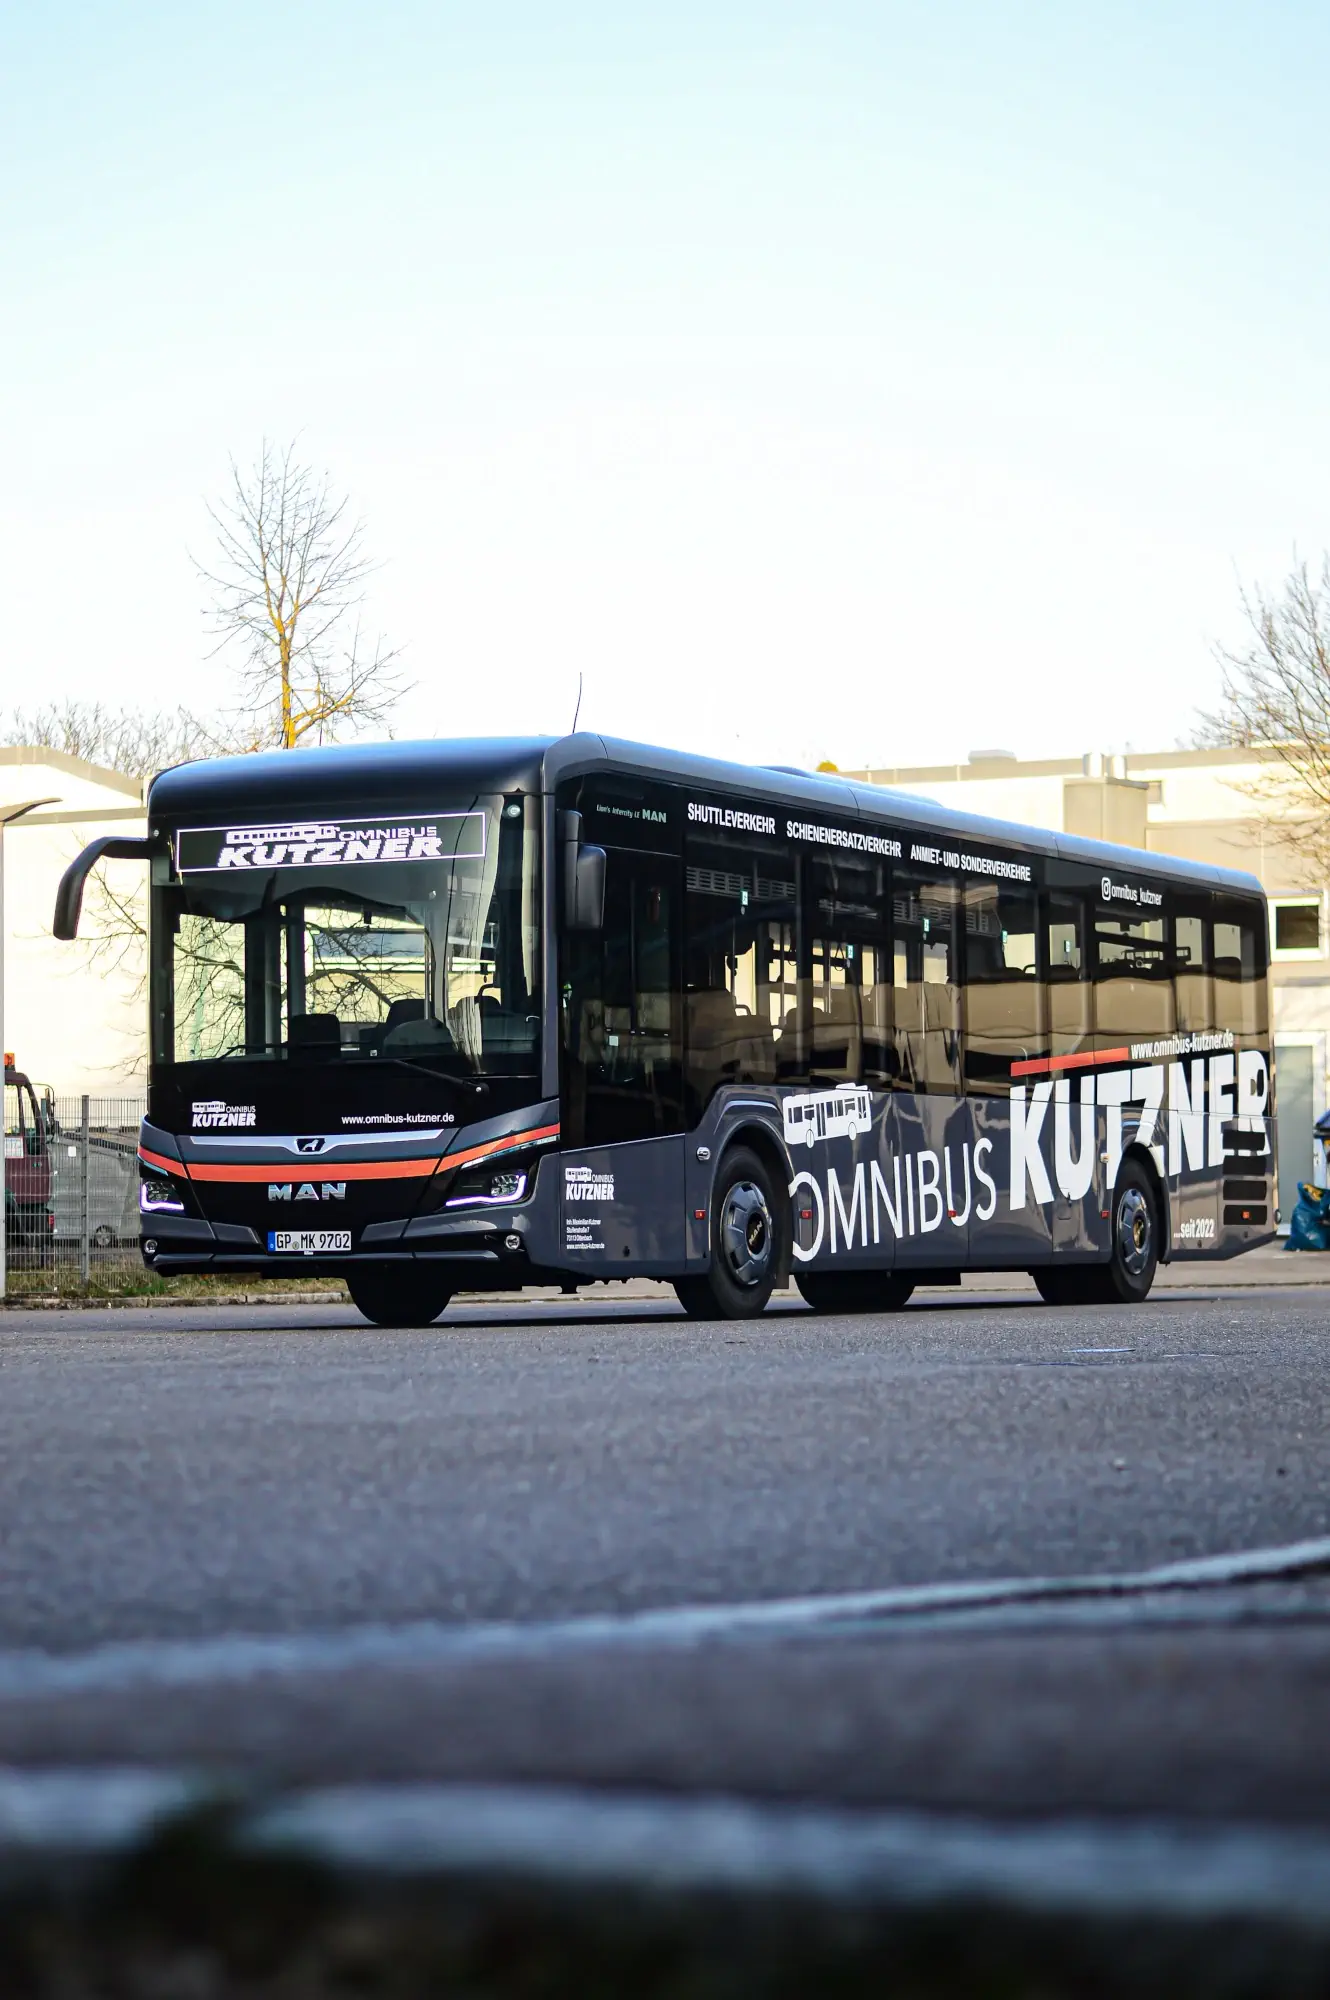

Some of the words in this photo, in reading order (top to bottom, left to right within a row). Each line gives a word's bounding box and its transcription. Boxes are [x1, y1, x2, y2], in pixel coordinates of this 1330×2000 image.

[642, 808, 667, 823] MAN
[338, 826, 437, 842] OMNIBUS
[687, 802, 776, 834] SHUTTLEVERKEHR
[786, 820, 901, 858] SCHIENENERSATZVERKEHR
[943, 852, 960, 869] UND
[960, 854, 1031, 882] SONDERVERKEHRE
[217, 836, 442, 867] KUTZNER
[1131, 1028, 1234, 1059] www.omnibus-kutzner.de
[225, 1105, 256, 1113] OMNIBUS
[192, 1112, 256, 1127] KUTZNER
[341, 1112, 454, 1124] www.omnibus-kutzner.de
[1010, 1050, 1271, 1211] KUTZNER
[591, 1174, 614, 1183] OMNIBUS
[268, 1183, 346, 1201] MAN
[565, 1183, 615, 1200] KUTZNER
[788, 1137, 997, 1262] OMNIBUS
[1195, 1218, 1215, 1238] 2022
[276, 1234, 291, 1249] GP
[300, 1234, 316, 1249] MK
[319, 1233, 350, 1249] 9702
